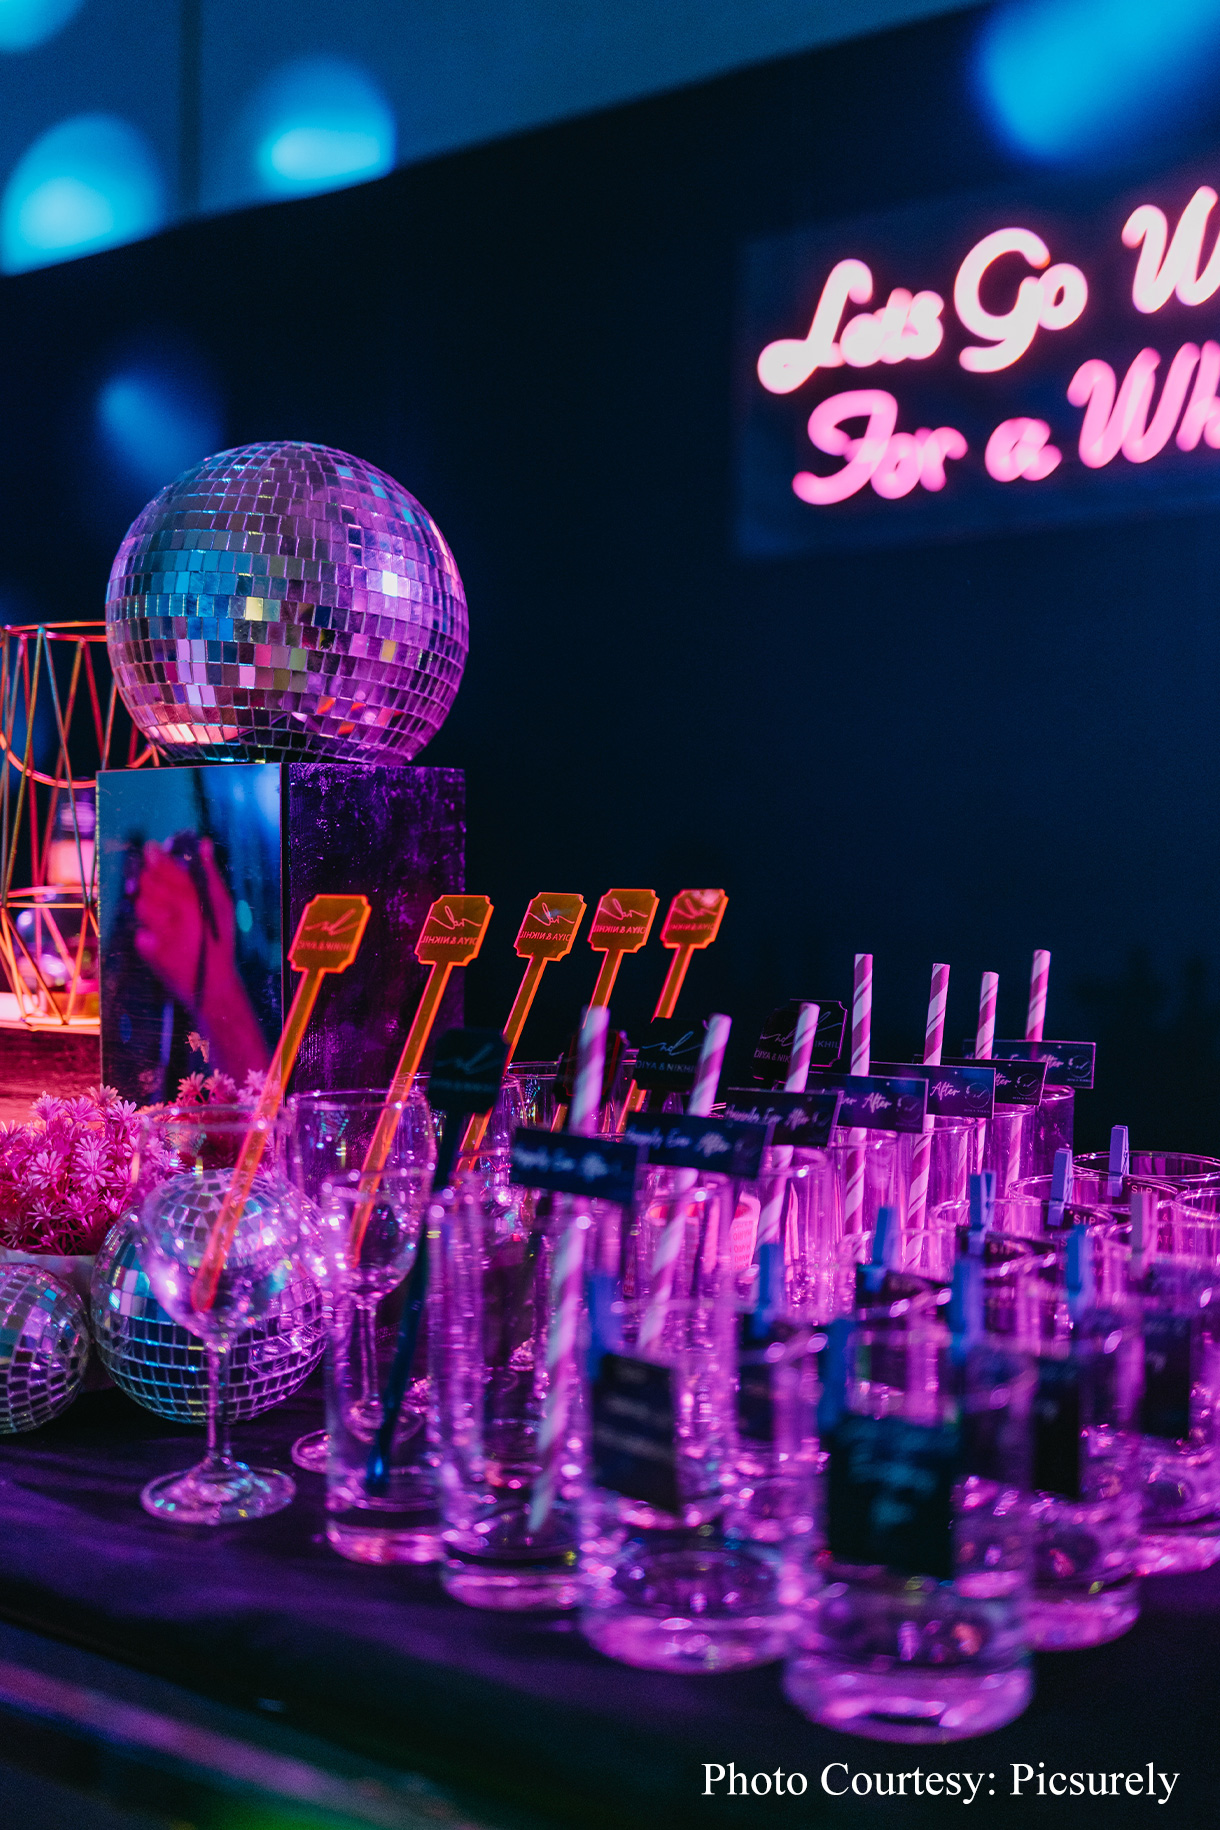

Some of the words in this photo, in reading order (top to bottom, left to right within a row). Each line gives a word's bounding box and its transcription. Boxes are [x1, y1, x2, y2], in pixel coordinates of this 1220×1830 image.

[954, 227, 1088, 373] Go
[792, 389, 968, 505] For
[985, 417, 1062, 483] a
[666, 1063, 695, 1074] NIKHI
[929, 1081, 960, 1101] After
[861, 1092, 892, 1113] After
[1073, 1214, 1096, 1226] SIP
